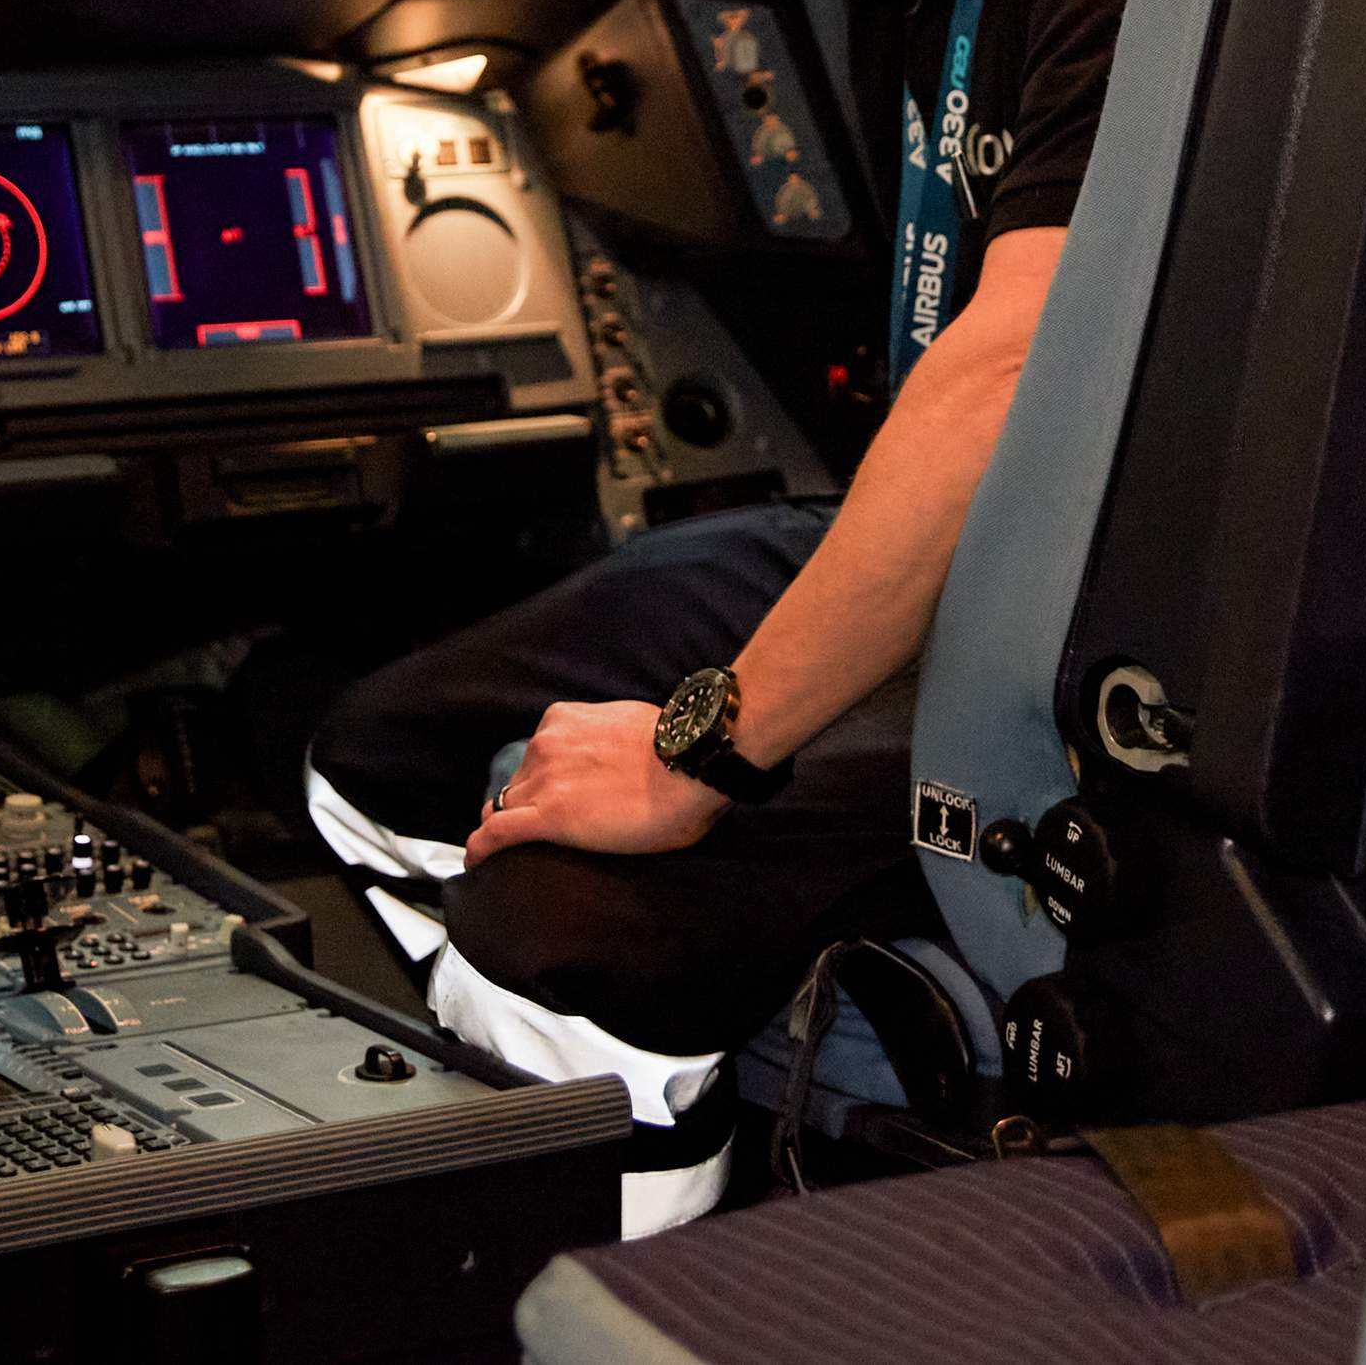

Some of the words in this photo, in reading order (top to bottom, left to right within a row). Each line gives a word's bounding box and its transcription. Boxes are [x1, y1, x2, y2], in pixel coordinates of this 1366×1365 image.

[910, 231, 949, 347] AIRBUS
[921, 783, 972, 812] UNLOCK
[929, 831, 963, 852] LOCK
[1067, 830, 1080, 844] UP
[1045, 852, 1085, 894] LUMBAR
[1048, 895, 1072, 922] DOWN
[1028, 1018, 1043, 1082] LUMBAR
[1056, 1052, 1066, 1078] AFT
